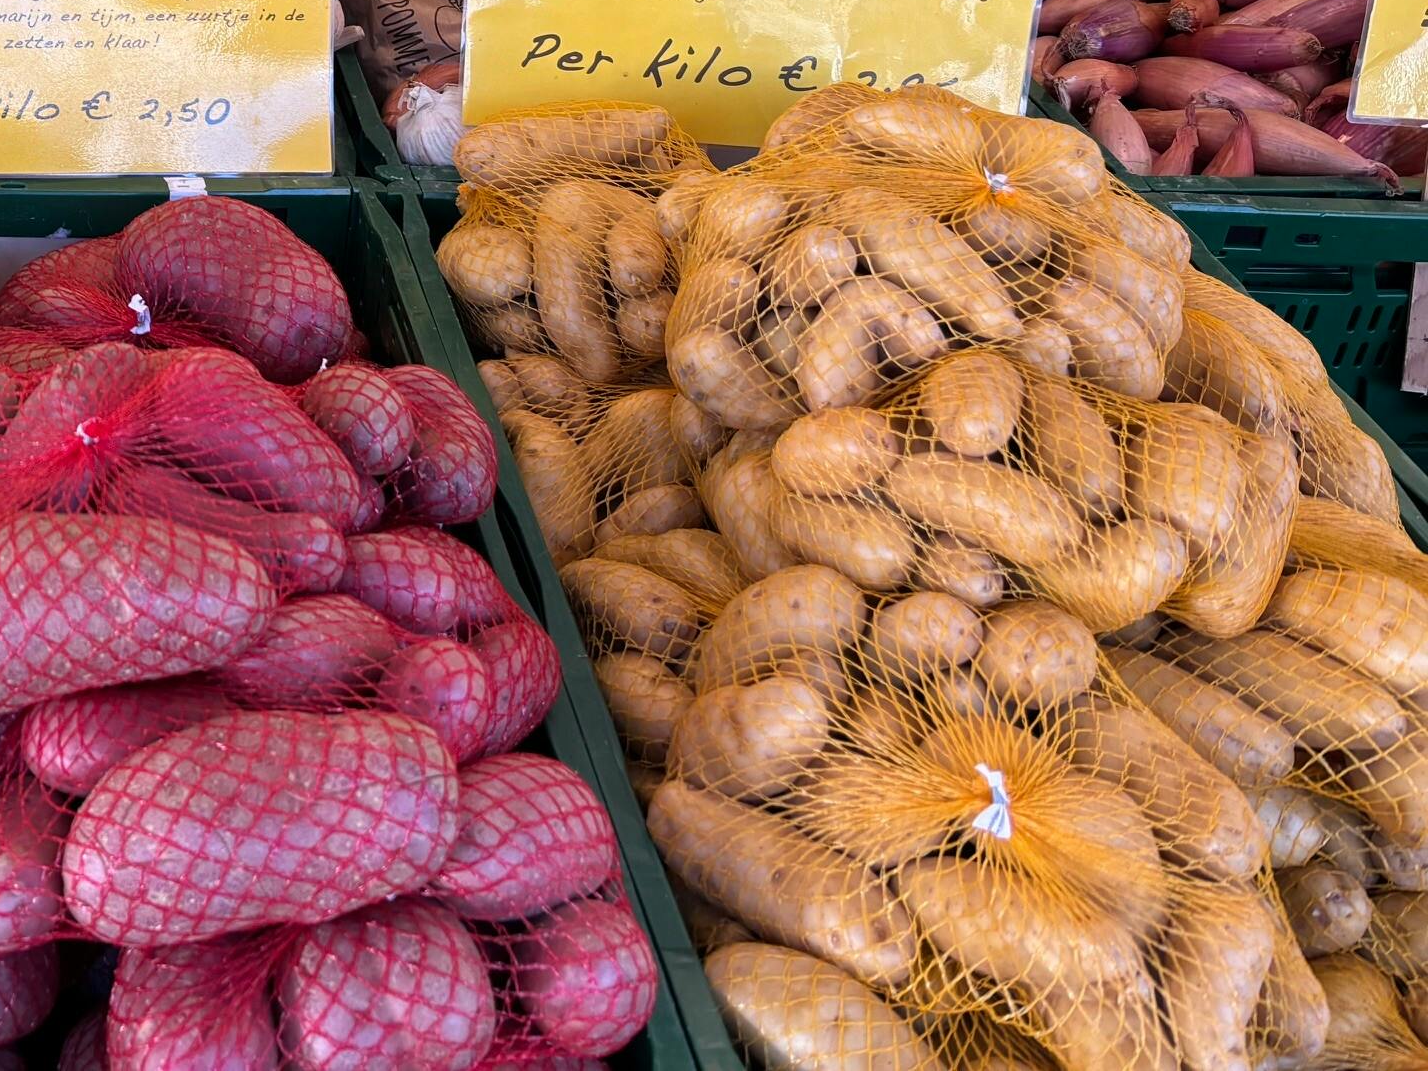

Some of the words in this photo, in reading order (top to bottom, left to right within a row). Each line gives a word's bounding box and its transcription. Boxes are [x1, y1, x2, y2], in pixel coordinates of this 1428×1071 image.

[61, 12, 82, 22] en
[91, 9, 136, 27] tijm,
[145, 12, 177, 22] een
[185, 10, 250, 27] uurtje
[259, 10, 277, 21] in
[285, 9, 305, 22] de
[4, 36, 64, 49] zetten
[74, 38, 94, 49] en
[104, 31, 160, 50] klaar!
[520, 32, 614, 76] Per
[642, 38, 753, 90] kilo
[777, 53, 819, 93] €
[81, 89, 114, 122] €
[138, 95, 232, 128] 2,50
